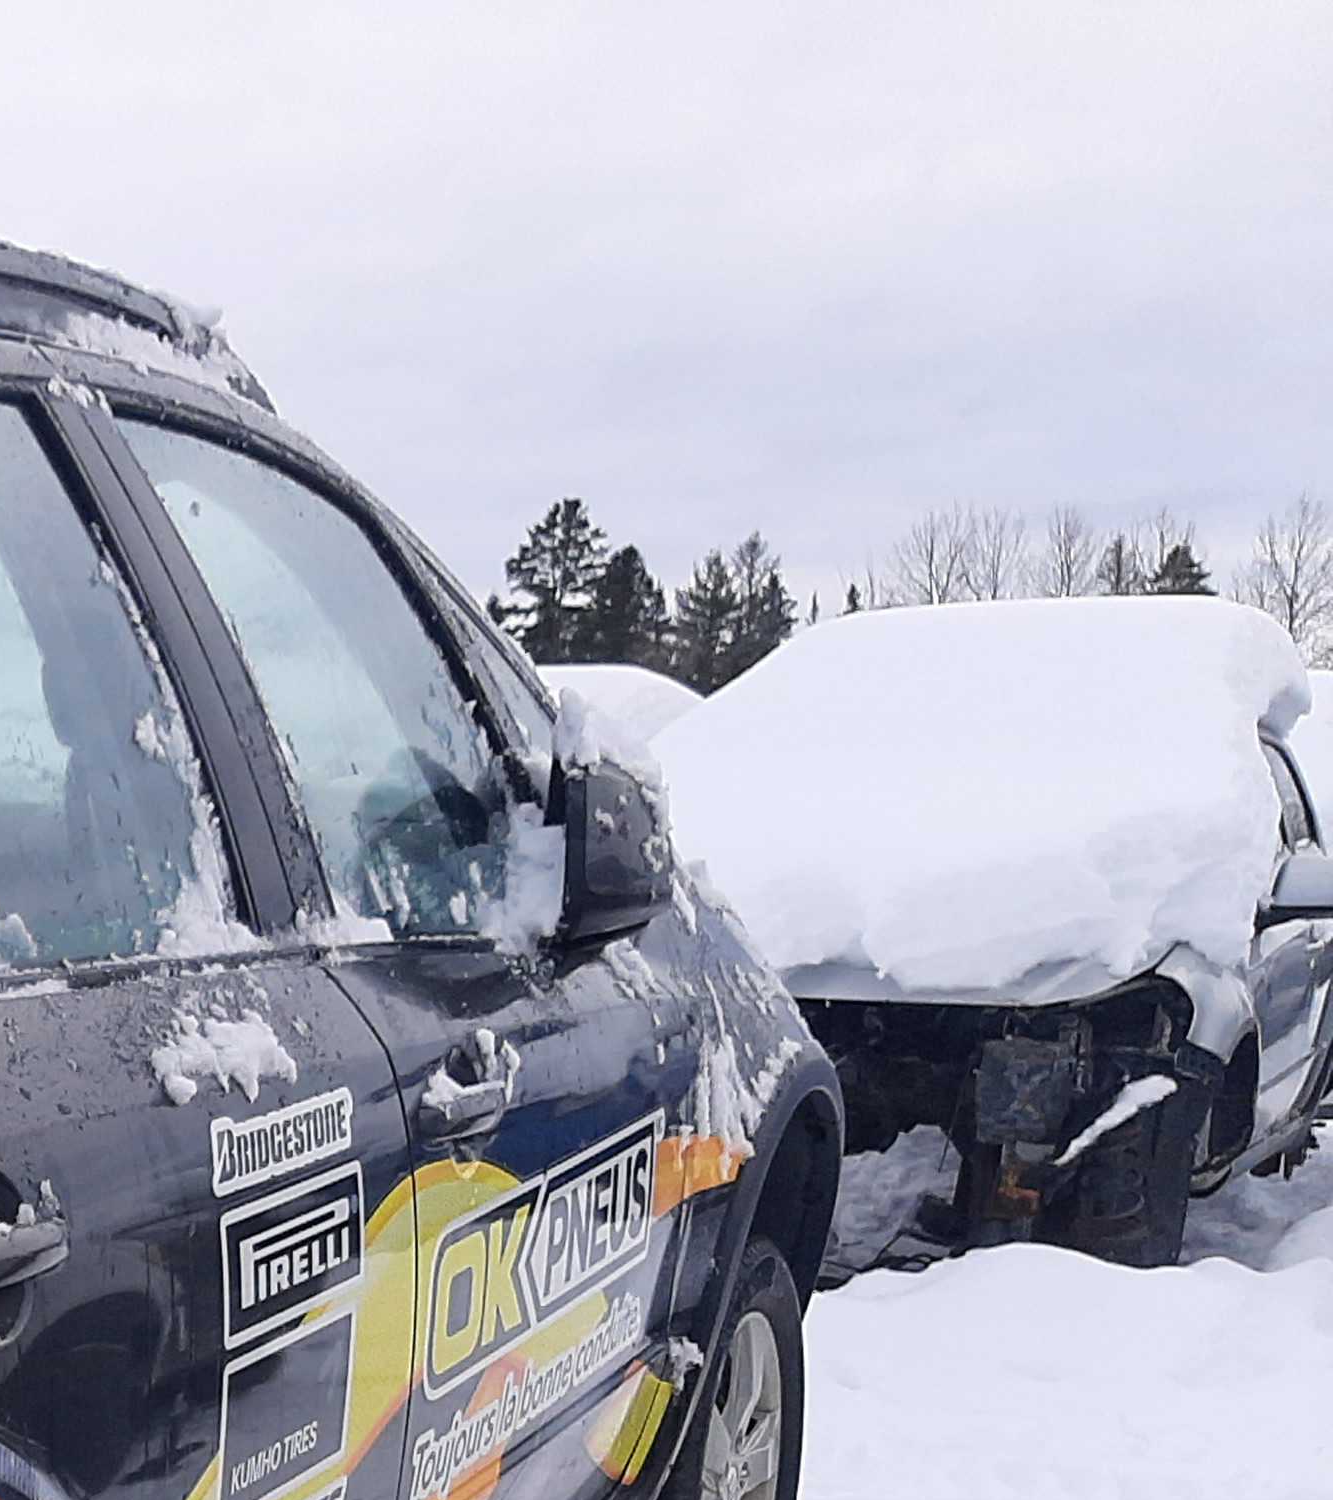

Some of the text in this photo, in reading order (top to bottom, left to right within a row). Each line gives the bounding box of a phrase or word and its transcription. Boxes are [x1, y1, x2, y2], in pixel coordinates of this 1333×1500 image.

[215, 1098, 349, 1186] BRIDGESTONE
[238, 1197, 350, 1310] PIRELLI
[433, 1147, 650, 1376] OK PNEUS
[230, 1421, 318, 1494] KUMHO TIRES
[412, 1408, 497, 1500] Toujours
[499, 1377, 517, 1435] la
[520, 1353, 573, 1417] bonne
